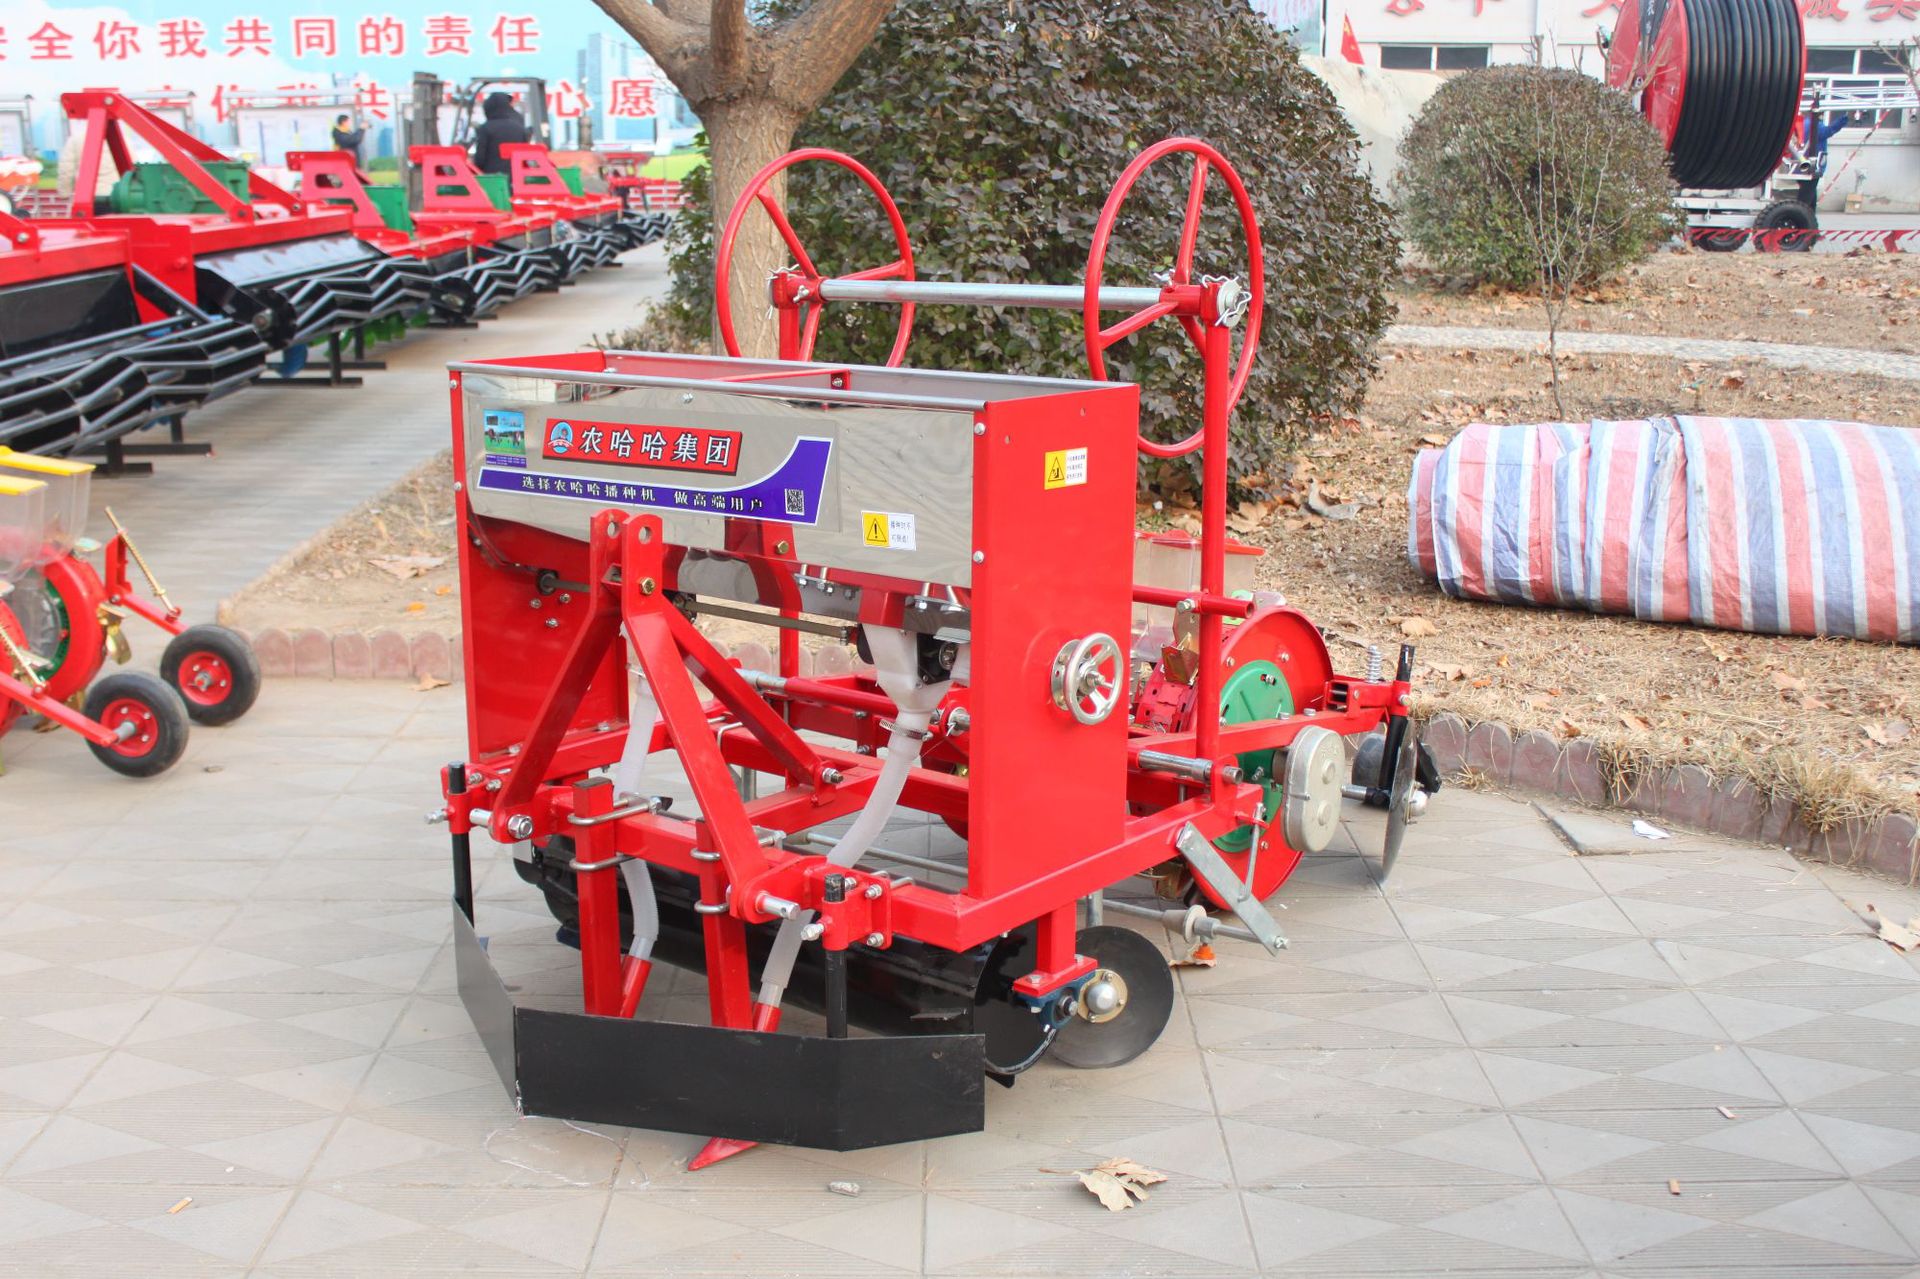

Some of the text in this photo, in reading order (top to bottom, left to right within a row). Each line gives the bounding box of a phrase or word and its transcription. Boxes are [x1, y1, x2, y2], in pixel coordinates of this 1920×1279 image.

[0, 15, 540, 60] 全你我共同的责任
[579, 425, 733, 468] 农哈哈集团
[521, 475, 764, 512] 选择农哈哈播种机 做高端用户
